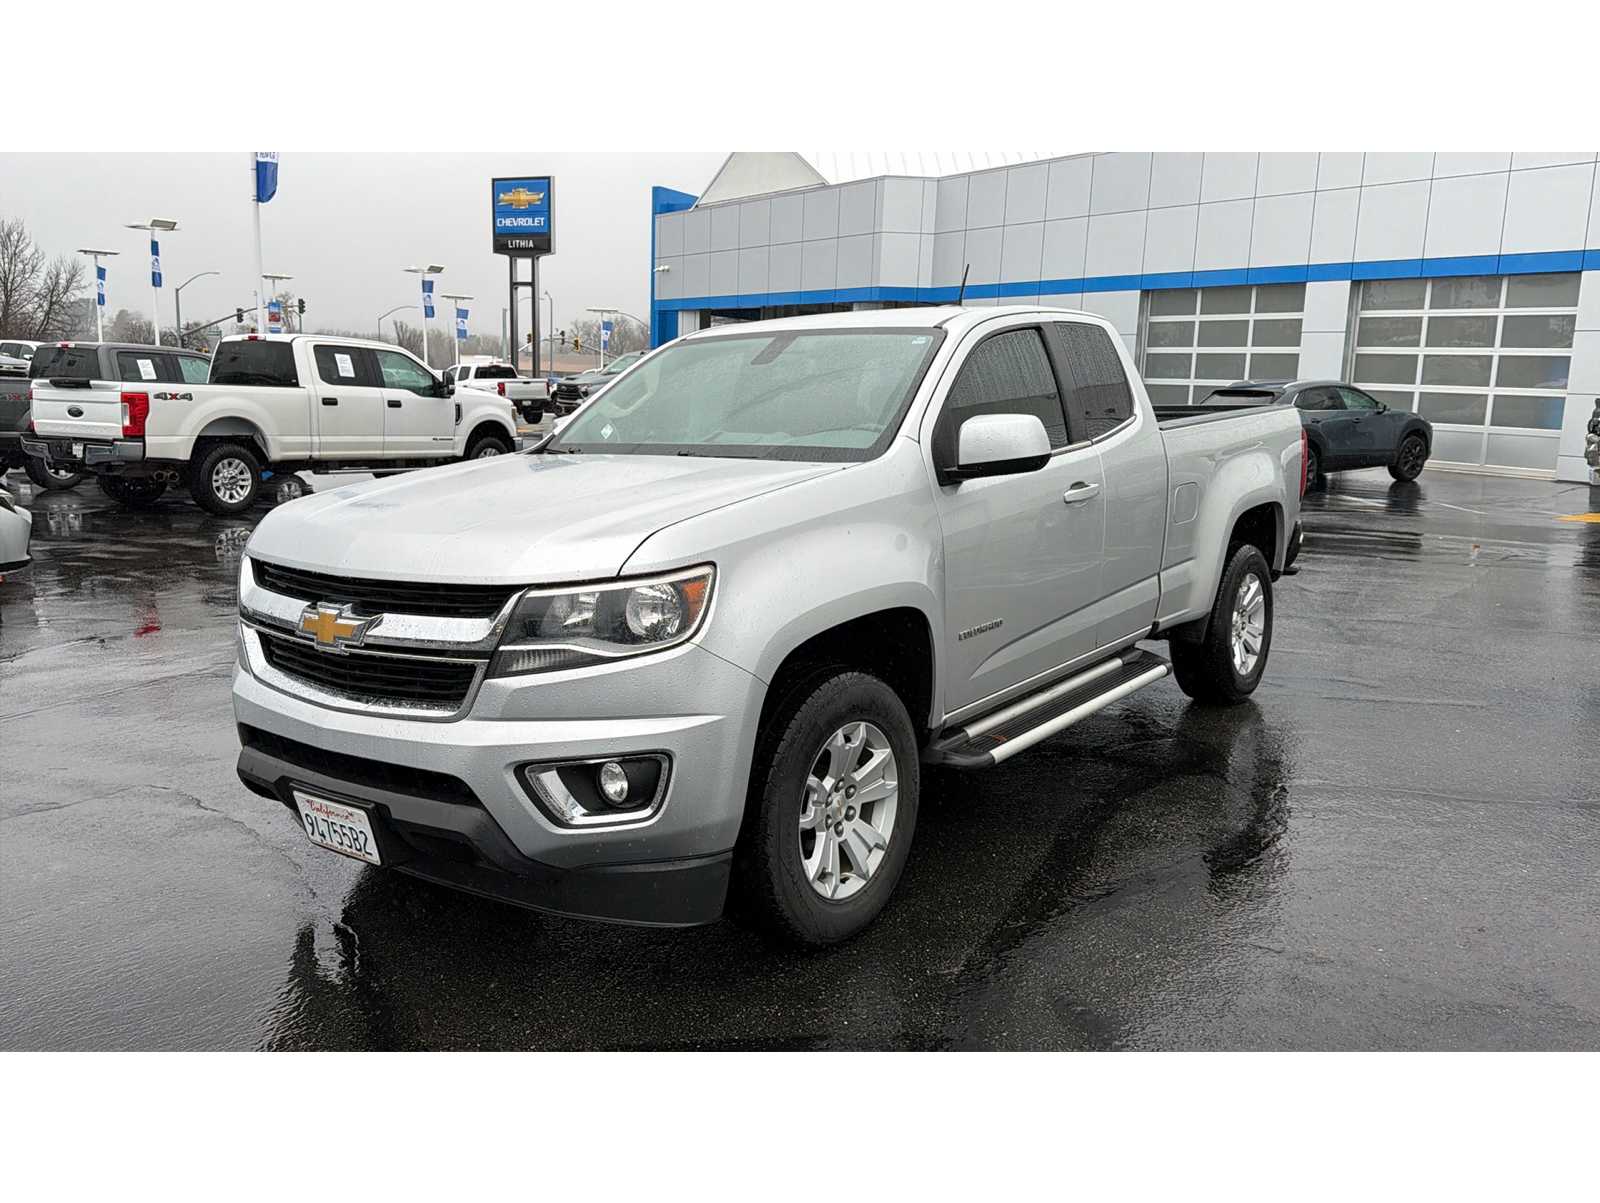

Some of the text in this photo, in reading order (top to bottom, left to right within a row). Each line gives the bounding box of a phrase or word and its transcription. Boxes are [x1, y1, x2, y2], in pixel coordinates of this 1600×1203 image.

[496, 217, 545, 227] CHEVROLET
[507, 239, 534, 249] LITHIA
[305, 813, 373, 856] 94755B2
